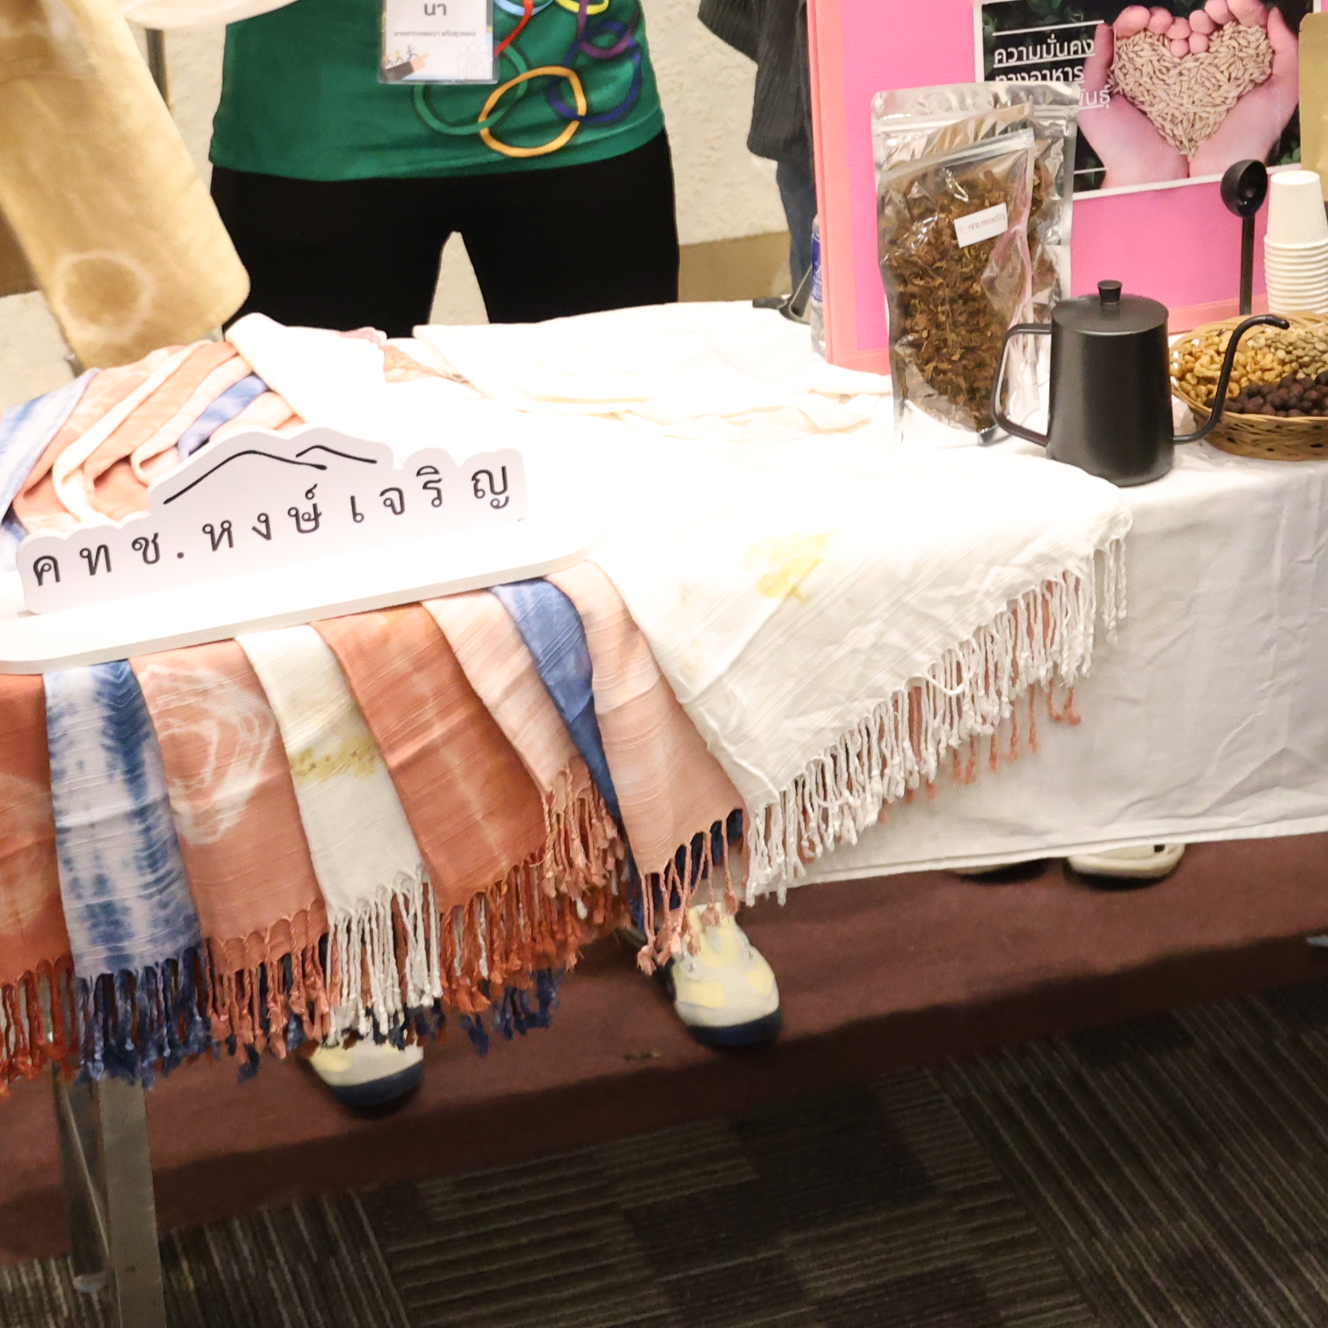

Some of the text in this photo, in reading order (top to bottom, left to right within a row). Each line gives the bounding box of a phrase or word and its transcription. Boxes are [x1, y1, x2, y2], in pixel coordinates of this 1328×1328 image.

[424, 3, 447, 16] นา
[994, 33, 1095, 64] ความมั่นคง
